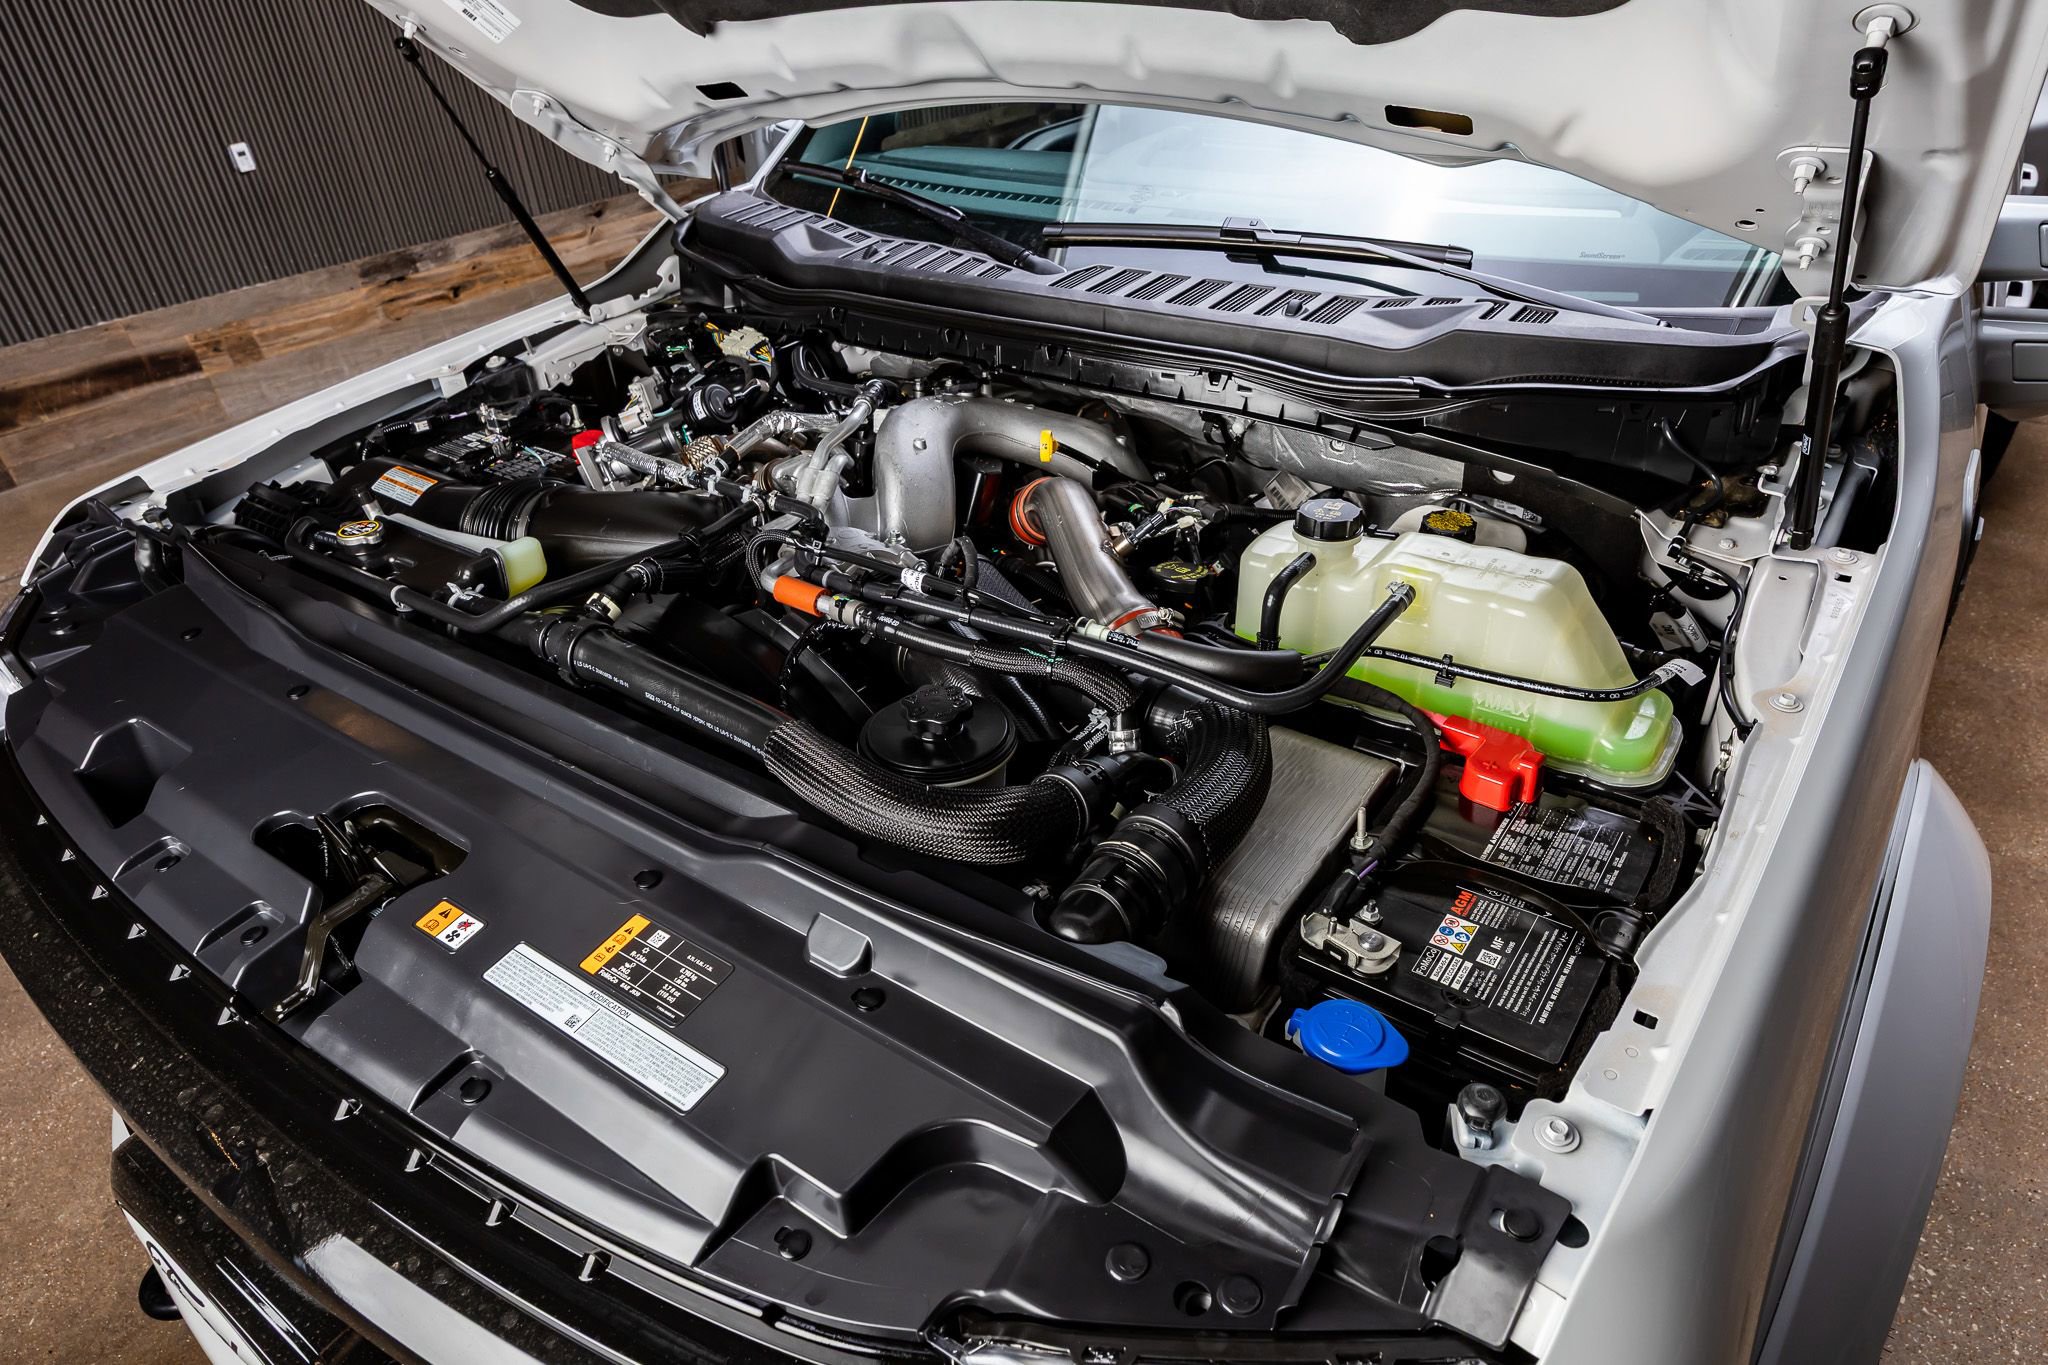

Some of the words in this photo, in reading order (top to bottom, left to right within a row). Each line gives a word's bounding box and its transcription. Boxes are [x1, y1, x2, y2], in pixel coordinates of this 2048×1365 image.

[1485, 694, 1531, 719] MAX
[1451, 888, 1472, 915] AGM
[1491, 935, 1505, 951] MF
[629, 950, 647, 964] R-134a
[1416, 945, 1440, 975] FoMoCo
[598, 968, 618, 984] FoMoCo
[587, 988, 631, 1019] MODIFICATION
